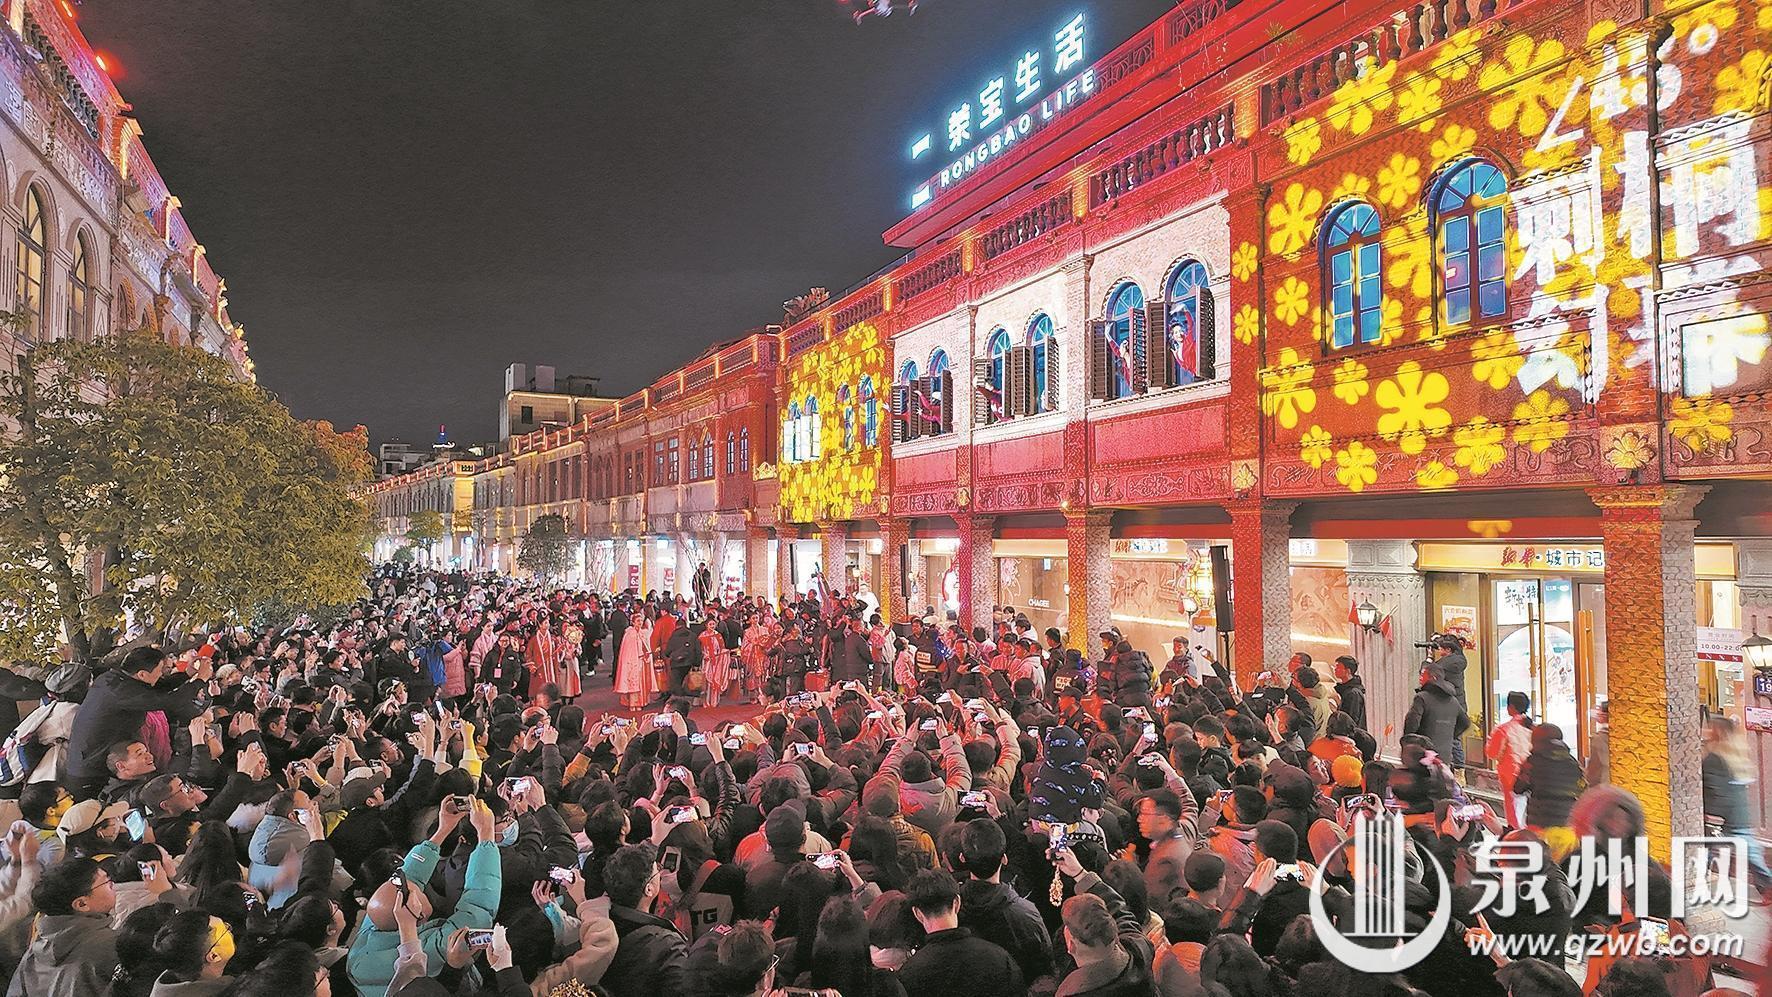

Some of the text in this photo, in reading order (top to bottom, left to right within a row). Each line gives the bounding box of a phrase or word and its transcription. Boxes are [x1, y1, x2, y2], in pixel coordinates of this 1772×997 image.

[940, 70, 1095, 187] RONGBAO LIFE
[1028, 598, 1050, 608] CHAGEE
